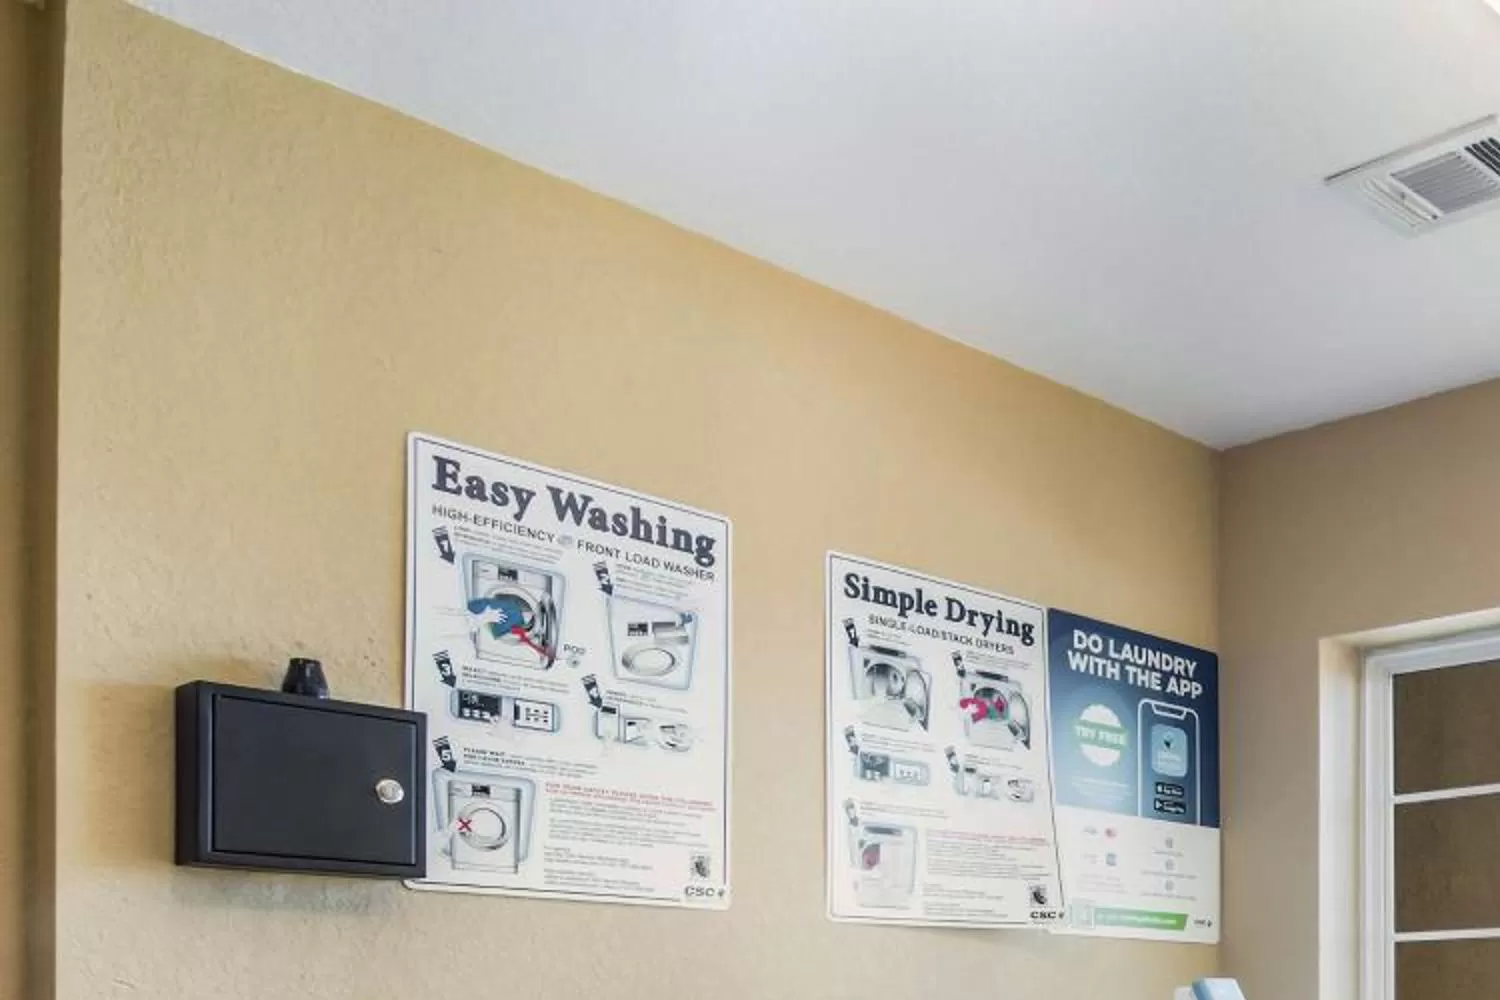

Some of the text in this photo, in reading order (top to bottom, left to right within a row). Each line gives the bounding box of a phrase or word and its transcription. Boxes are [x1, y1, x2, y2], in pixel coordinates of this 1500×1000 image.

[431, 455, 536, 522] Easy
[546, 484, 717, 568] Washing
[431, 503, 555, 543] HIGH-EFFICIENCY
[577, 538, 621, 560] FRONT
[625, 551, 661, 570] LOAD
[663, 560, 716, 583] WASHER
[843, 572, 1036, 647] Simple Drying
[1067, 650, 1204, 699] WITH THE APP
[1073, 629, 1198, 678] DO LAUNDRY
